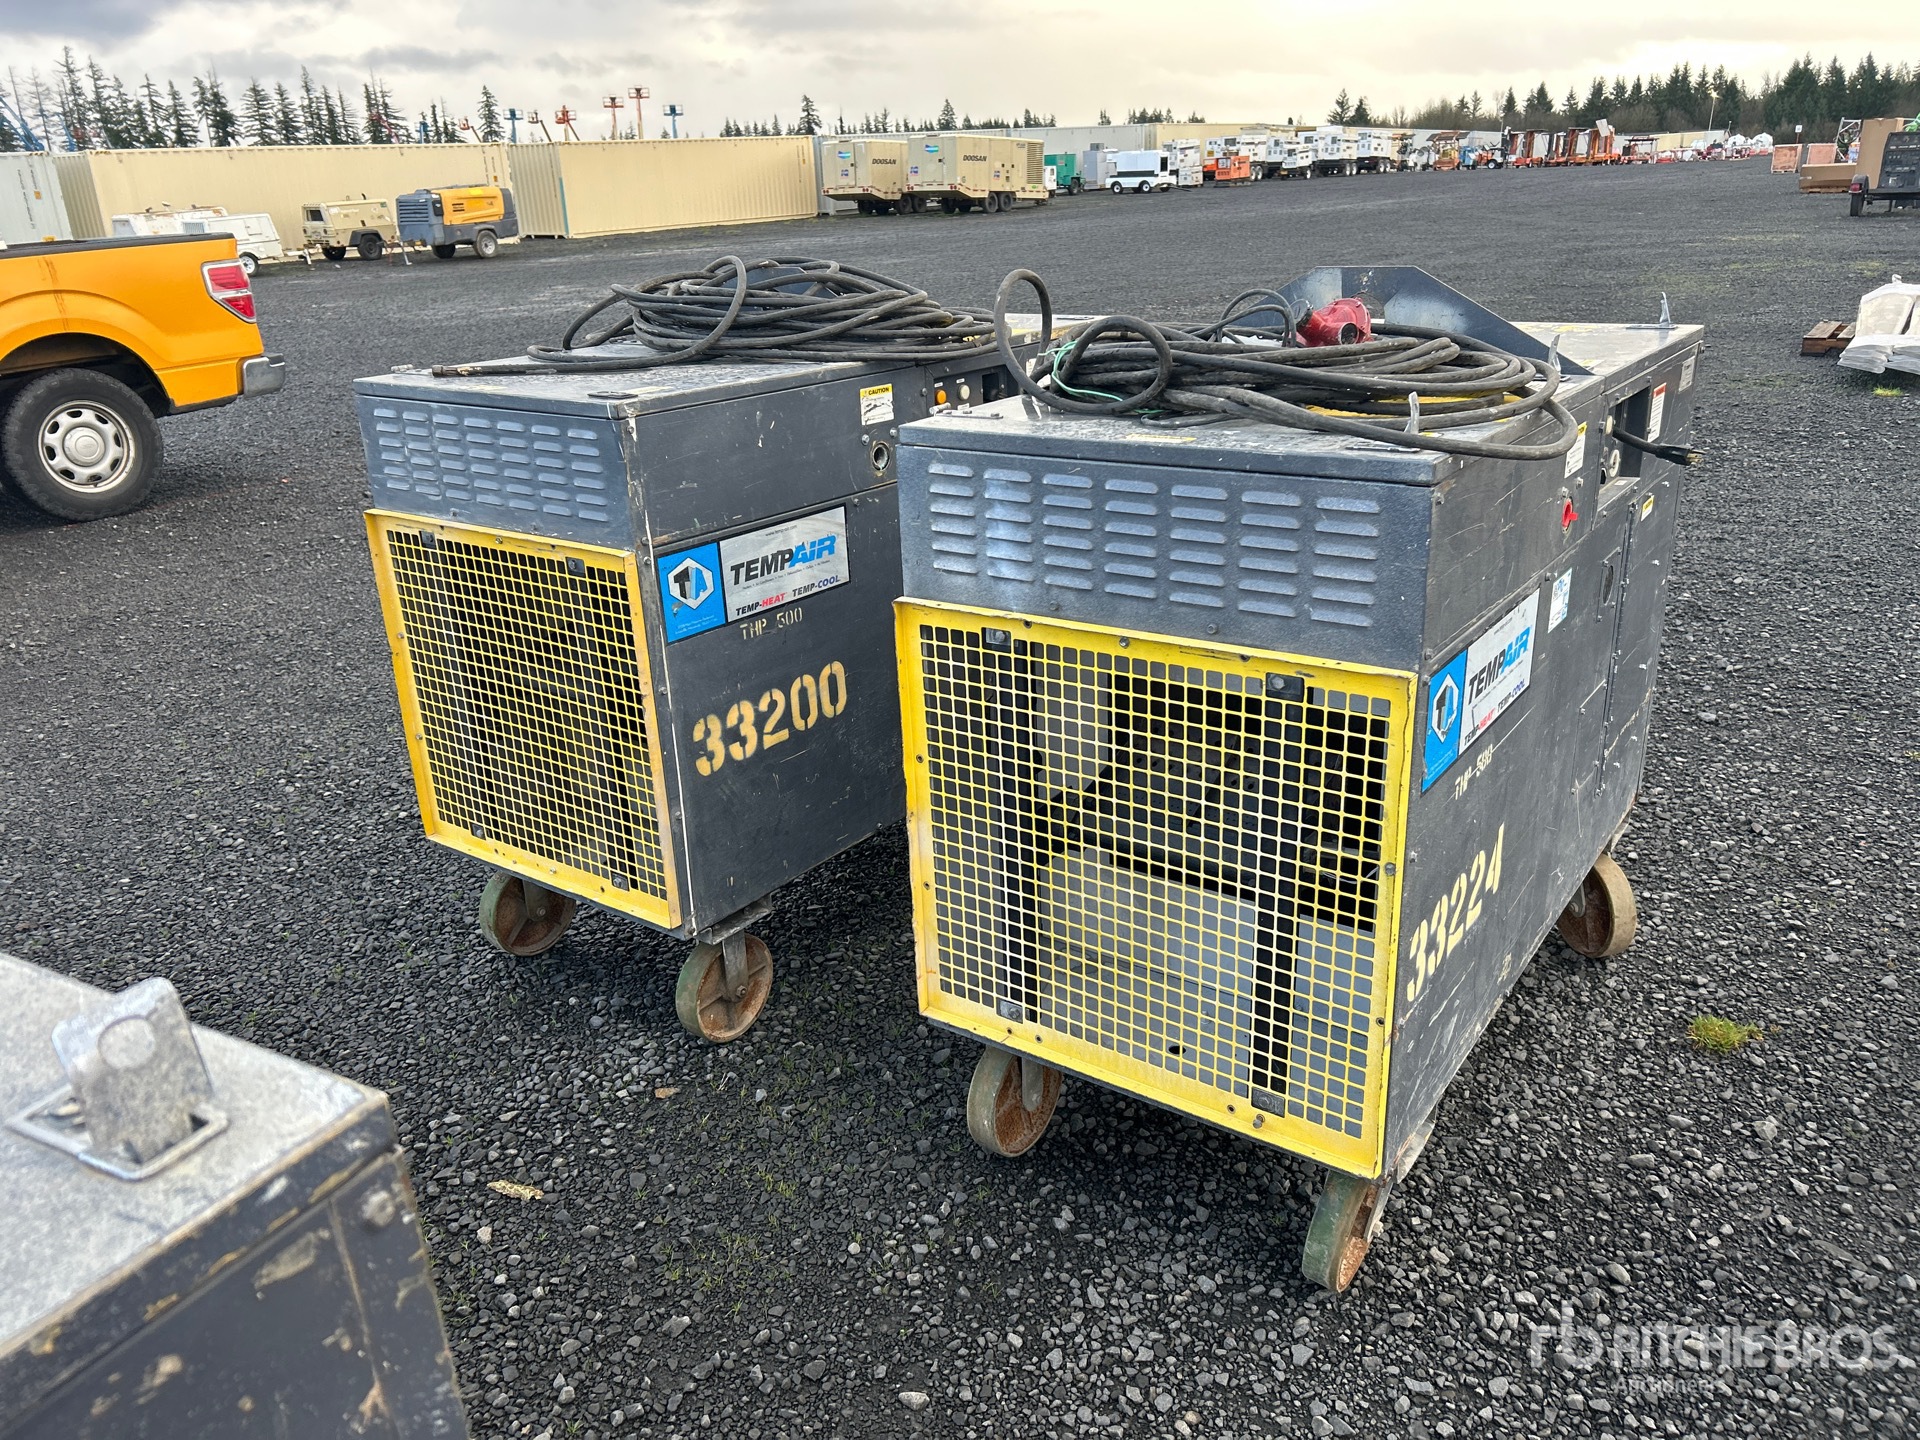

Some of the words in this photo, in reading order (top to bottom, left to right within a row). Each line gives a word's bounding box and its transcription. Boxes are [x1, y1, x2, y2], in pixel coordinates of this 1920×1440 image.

[962, 154, 987, 162] DOOSAN
[868, 387, 890, 396] CAUTION
[735, 592, 787, 616] TEMP-HEAT
[792, 574, 841, 598] TEMP-COOL
[739, 618, 768, 640] THP
[776, 607, 803, 628] 500
[692, 660, 848, 777] 33200
[1455, 766, 1472, 800] THP
[1476, 743, 1494, 778] 500
[1407, 822, 1505, 1002] 33224
